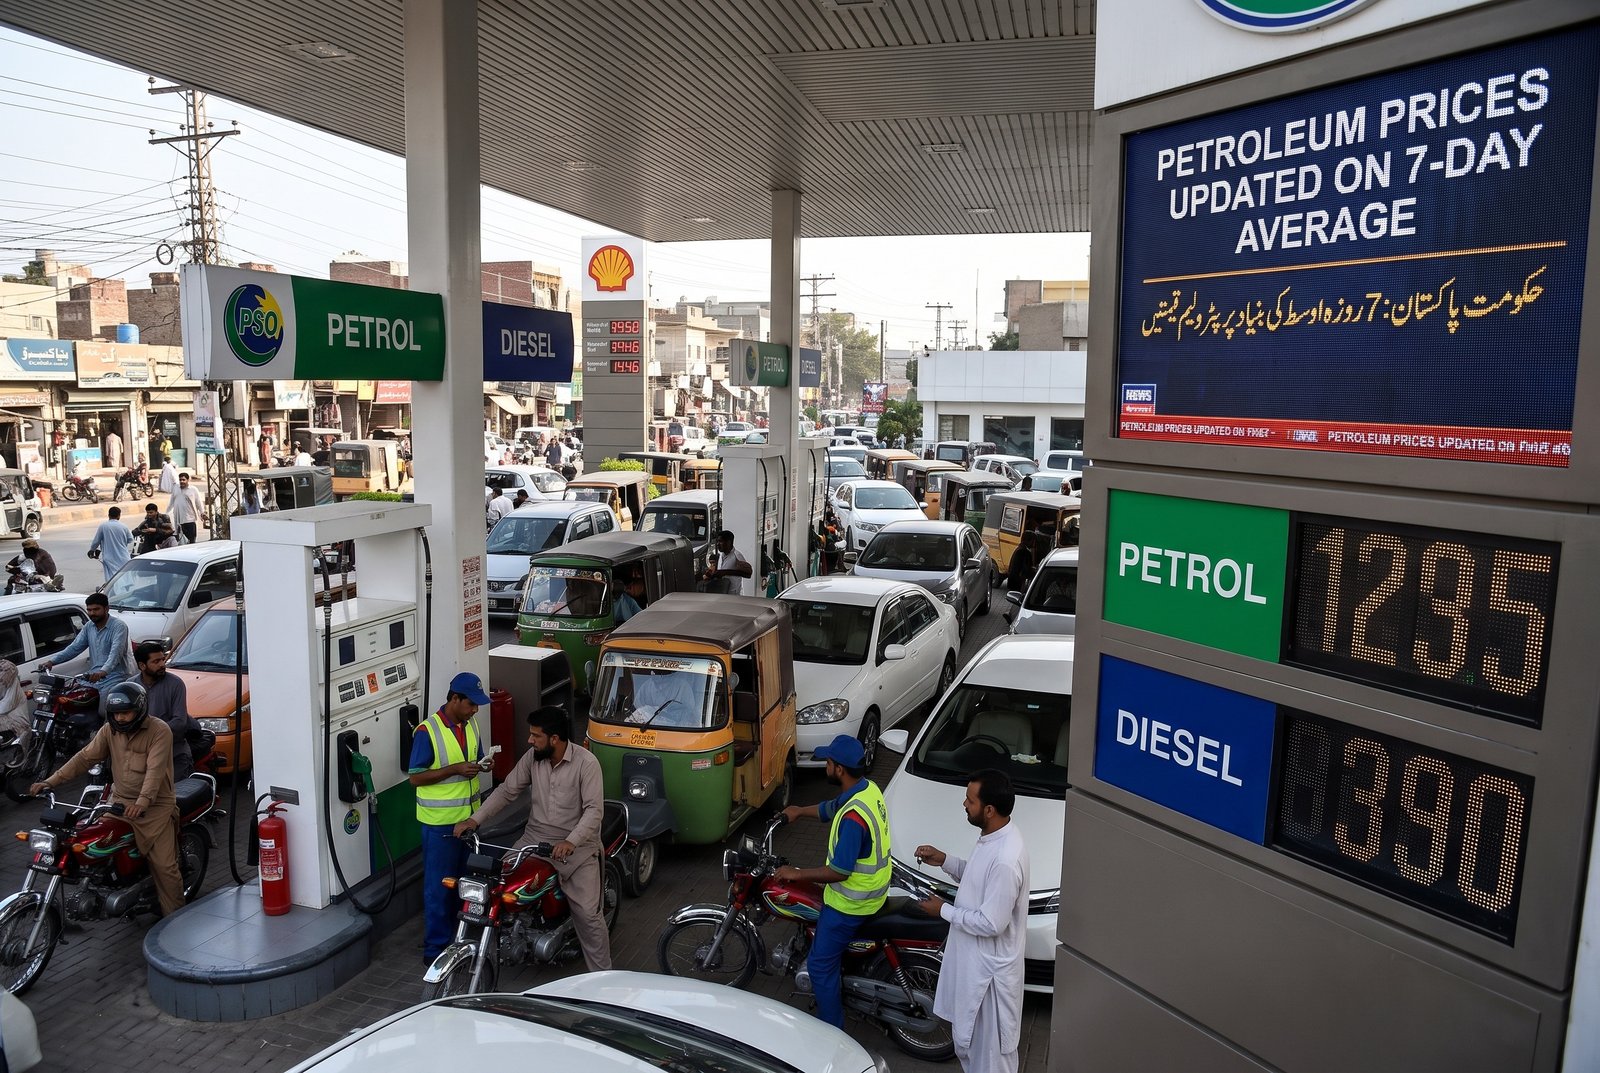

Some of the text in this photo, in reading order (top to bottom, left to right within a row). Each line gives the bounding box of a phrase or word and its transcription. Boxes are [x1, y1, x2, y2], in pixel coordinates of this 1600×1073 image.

[1158, 67, 1549, 181] PETROLEUM PRICES
[1169, 123, 1543, 220] UPDATED ON 7-DAY
[1234, 198, 1417, 254] AVERAGE
[1463, 265, 1547, 317] حکومت
[240, 307, 279, 337] PSO
[327, 313, 421, 351] PETROL
[501, 329, 556, 358] DIESEL
[763, 355, 785, 373] PETROL
[1165, 423, 1193, 434] PRICES
[1194, 425, 1231, 436] UPDATED
[1328, 431, 1391, 445] PETROLEUM
[1394, 434, 1435, 447] PRICES
[1119, 542, 1267, 605] PETROL
[1311, 527, 1551, 697] 1295
[1116, 709, 1243, 787] DIESEL
